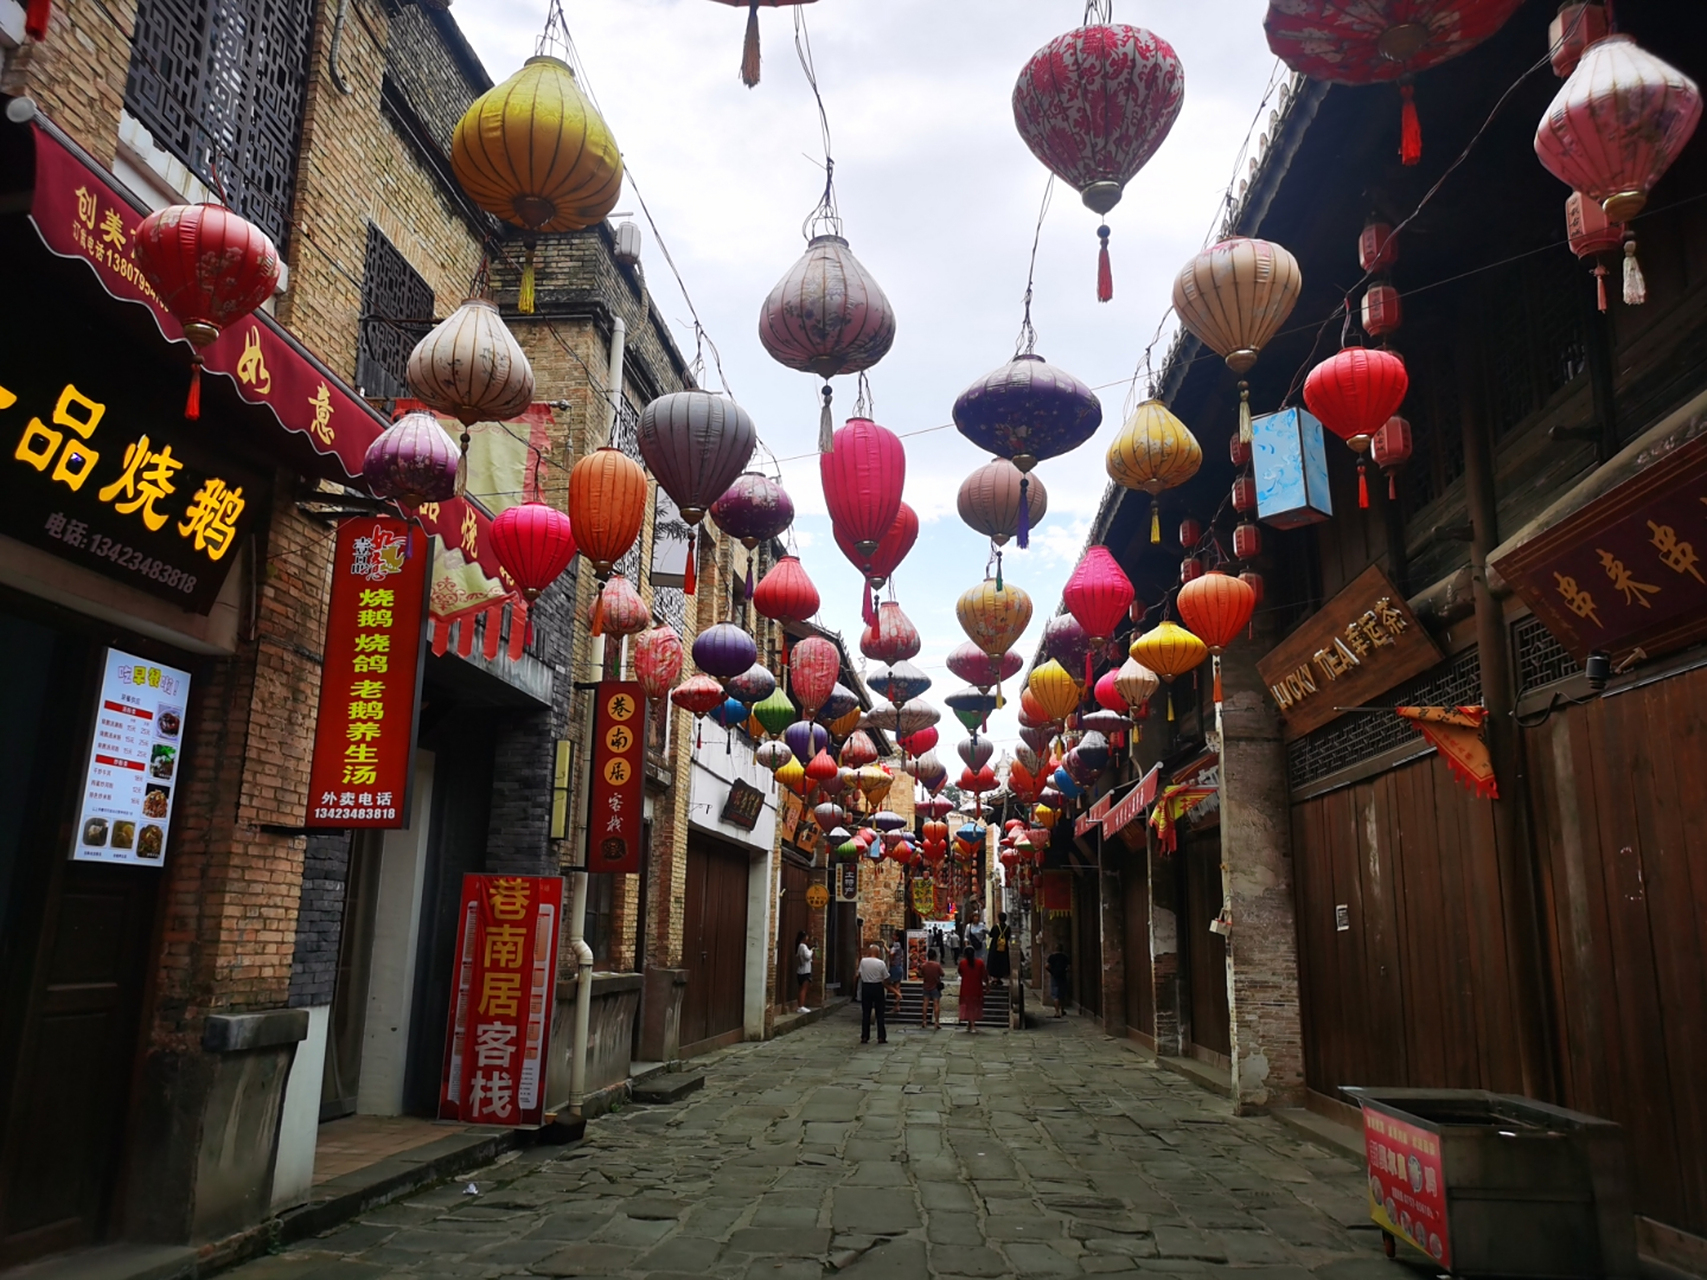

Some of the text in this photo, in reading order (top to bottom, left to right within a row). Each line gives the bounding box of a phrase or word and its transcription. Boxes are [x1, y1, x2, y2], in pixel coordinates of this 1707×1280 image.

[0, 384, 245, 561] 品烧鹅
[341, 589, 394, 786] 烧鹅 烧鸽 老鹅养生汤
[1270, 663, 1318, 710] LUCKY
[1313, 636, 1360, 681] TEA
[314, 807, 396, 820] 13423483818
[321, 791, 392, 806] 外卖电话
[606, 792, 624, 833] 客栈
[468, 877, 531, 1119] 巷南居客栈
